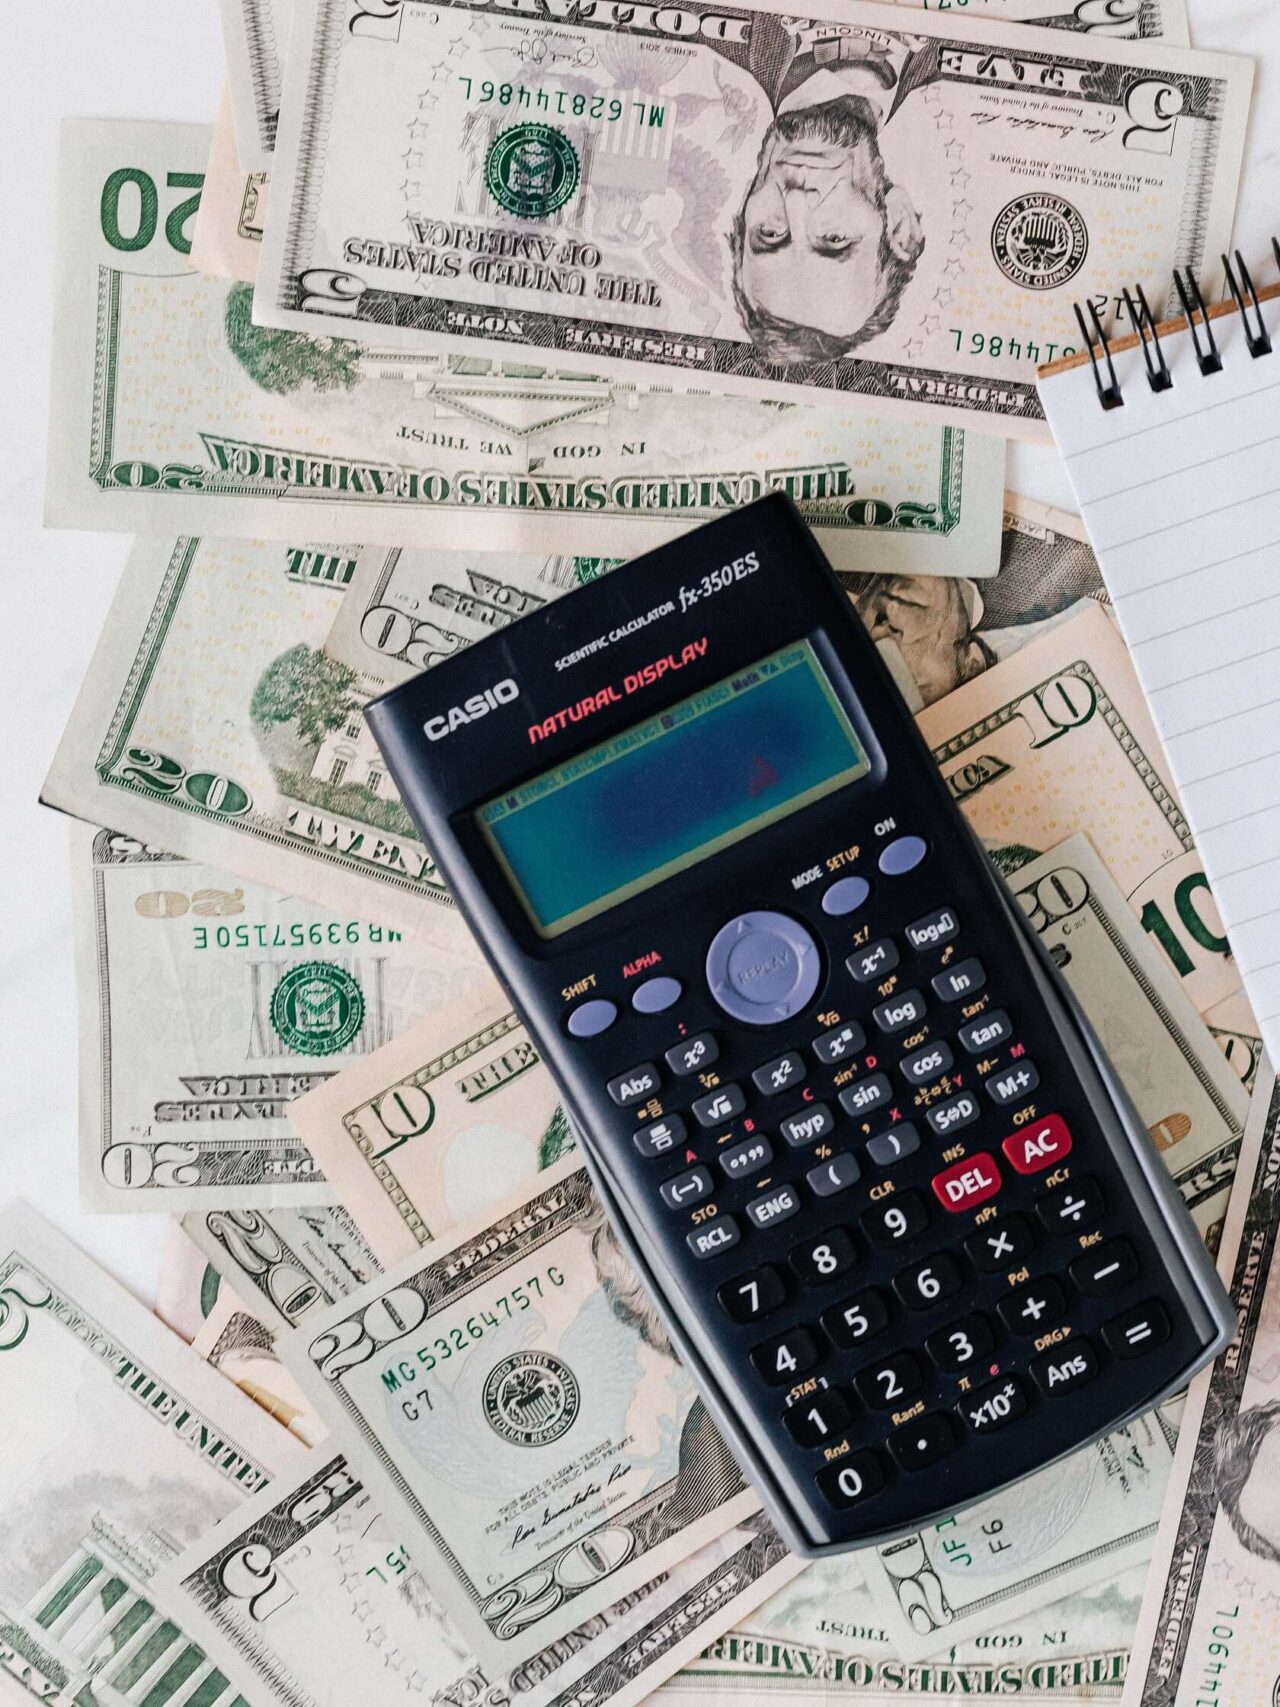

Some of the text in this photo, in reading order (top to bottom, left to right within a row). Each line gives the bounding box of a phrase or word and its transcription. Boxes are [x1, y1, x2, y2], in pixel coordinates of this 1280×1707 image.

[815, 26, 893, 46] LINCOLN
[939, 50, 1085, 93] FIVE
[1121, 78, 1184, 156] 5
[989, 153, 1028, 167] PRIVATE
[1009, 166, 1046, 178] TENDER
[1052, 164, 1087, 177] PUBLIC
[1047, 171, 1078, 184] LEGAL
[1090, 178, 1119, 190] NOTE
[411, 221, 602, 270] OF AMERICA
[342, 236, 662, 308] THE UNITED STATES
[300, 268, 368, 316] 5
[446, 310, 1026, 407] FEDERAL RESERVE NOTE
[396, 424, 648, 460] IN GOD WE TRUST
[110, 461, 204, 491] 20
[199, 432, 397, 496] AMERICA
[398, 461, 454, 504] OF
[456, 467, 609, 510] STATES
[844, 499, 942, 532] 20
[554, 551, 761, 672] SCIENTIFIC CALCULATOR fx-350ES
[527, 686, 623, 744] NATURAL
[623, 636, 709, 697] DISPLAY
[422, 677, 520, 742] CASIO
[1015, 675, 1097, 750] 10
[120, 747, 254, 817] 20
[873, 816, 897, 837] ON
[284, 806, 442, 888] TWEN
[790, 864, 824, 891] MODE
[135, 888, 246, 919] 20
[1139, 871, 1231, 978] 10
[622, 950, 663, 980] ALPHA
[737, 949, 792, 985] REPLAY
[561, 973, 598, 1002] SHIFT
[949, 972, 971, 994] ln
[883, 1000, 918, 1026] log
[970, 1020, 1004, 1046] tan
[912, 1050, 944, 1076] cos
[1009, 1042, 1026, 1059] M
[454, 1041, 541, 1103] THE
[619, 1072, 654, 1101] Abs
[996, 1071, 1031, 1100] M+
[801, 1087, 815, 1101] C
[852, 1083, 881, 1108] sin
[344, 1082, 436, 1161] 10
[744, 1118, 756, 1132] B
[789, 1113, 825, 1141] hyp
[1011, 1104, 1038, 1126] OFF
[686, 1149, 698, 1164] A
[941, 1143, 966, 1163] INS
[1023, 1128, 1059, 1164] AC
[100, 1141, 201, 1190] 20
[1045, 1166, 1071, 1188] nCr
[868, 1180, 896, 1201] CLR
[945, 1167, 993, 1203] DEL
[690, 1203, 718, 1225] STO
[754, 1192, 794, 1223] ENG
[883, 1207, 908, 1239] 9
[974, 1205, 999, 1226] nPr
[445, 1189, 567, 1279] FEDERAL
[696, 1226, 733, 1254] RCL
[1078, 1230, 1104, 1250] Rec
[811, 1244, 838, 1275] 8
[916, 1267, 942, 1299] 6
[1007, 1266, 1031, 1287] Pol
[738, 1281, 760, 1313] 7
[308, 1286, 430, 1382] 20
[843, 1304, 870, 1338] 5
[775, 1344, 798, 1373] 4
[948, 1331, 975, 1363] 3
[876, 1368, 905, 1401] 2
[1047, 1354, 1088, 1388] Ans
[113, 1354, 177, 1425] THE
[790, 1376, 818, 1401] STAT
[806, 1406, 829, 1435] 1
[823, 1439, 851, 1462] Rnd
[837, 1467, 864, 1498] 0
[217, 1543, 299, 1624] 5
[480, 1525, 637, 1641] 20
[624, 1570, 738, 1668] RESERVE
[1157, 1543, 1200, 1680] FEDERAL
[815, 1618, 890, 1642] TRUST
[975, 1629, 1068, 1649] IN GOD
[828, 1650, 1024, 1695] STATES OF
